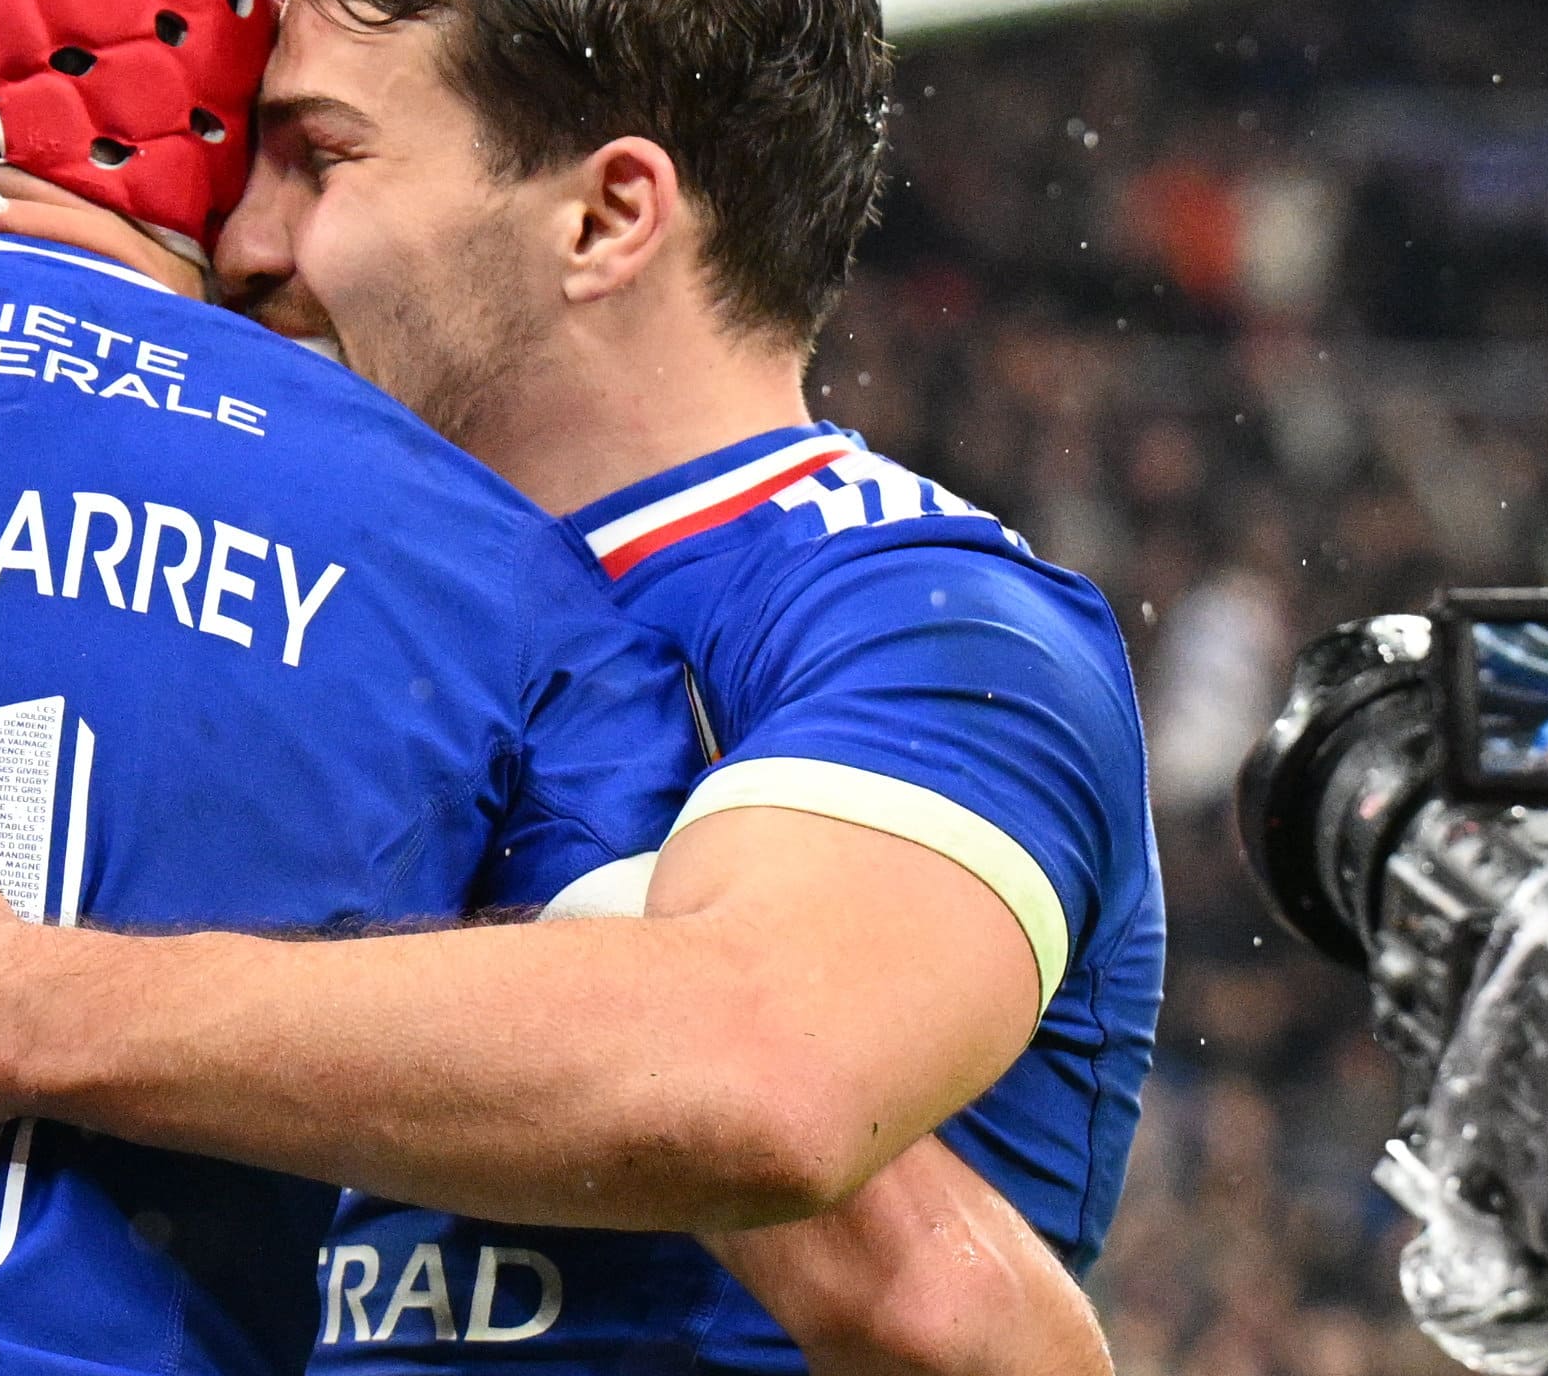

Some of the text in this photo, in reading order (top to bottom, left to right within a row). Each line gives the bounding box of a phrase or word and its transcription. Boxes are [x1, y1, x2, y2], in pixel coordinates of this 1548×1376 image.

[16, 729, 28, 737] LA
[28, 731, 53, 740] CROIX
[7, 737, 48, 749] VAUNAGE
[34, 749, 52, 758] LES
[37, 759, 51, 768] DE
[16, 766, 50, 776] GIVRES
[15, 776, 48, 785] RUGBY
[21, 785, 42, 794] GRIS
[26, 805, 46, 814] LES
[27, 815, 46, 823] LES
[16, 832, 44, 842] BLEUS
[5, 860, 41, 871] MAGNE
[7, 889, 39, 900] RUGBY
[318, 1243, 564, 1345] RAD
